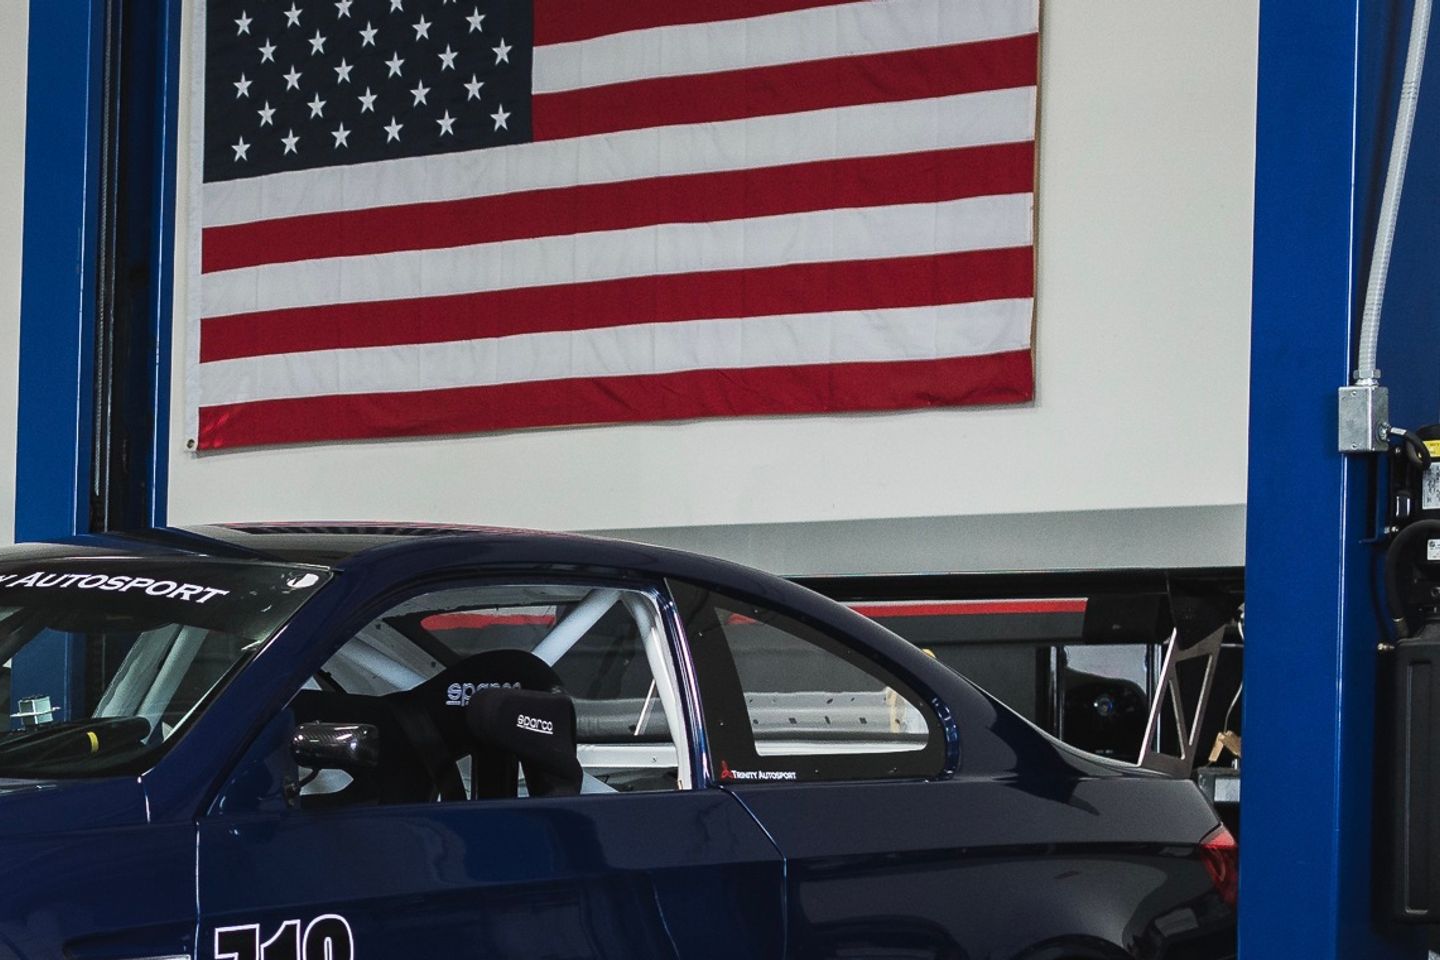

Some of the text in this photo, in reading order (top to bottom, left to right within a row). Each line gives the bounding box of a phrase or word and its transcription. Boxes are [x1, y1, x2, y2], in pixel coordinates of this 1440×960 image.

[6, 571, 230, 604] AUTOSPORT
[517, 714, 554, 733] sparco
[731, 769, 797, 780] TRINITY AUTOSPORT
